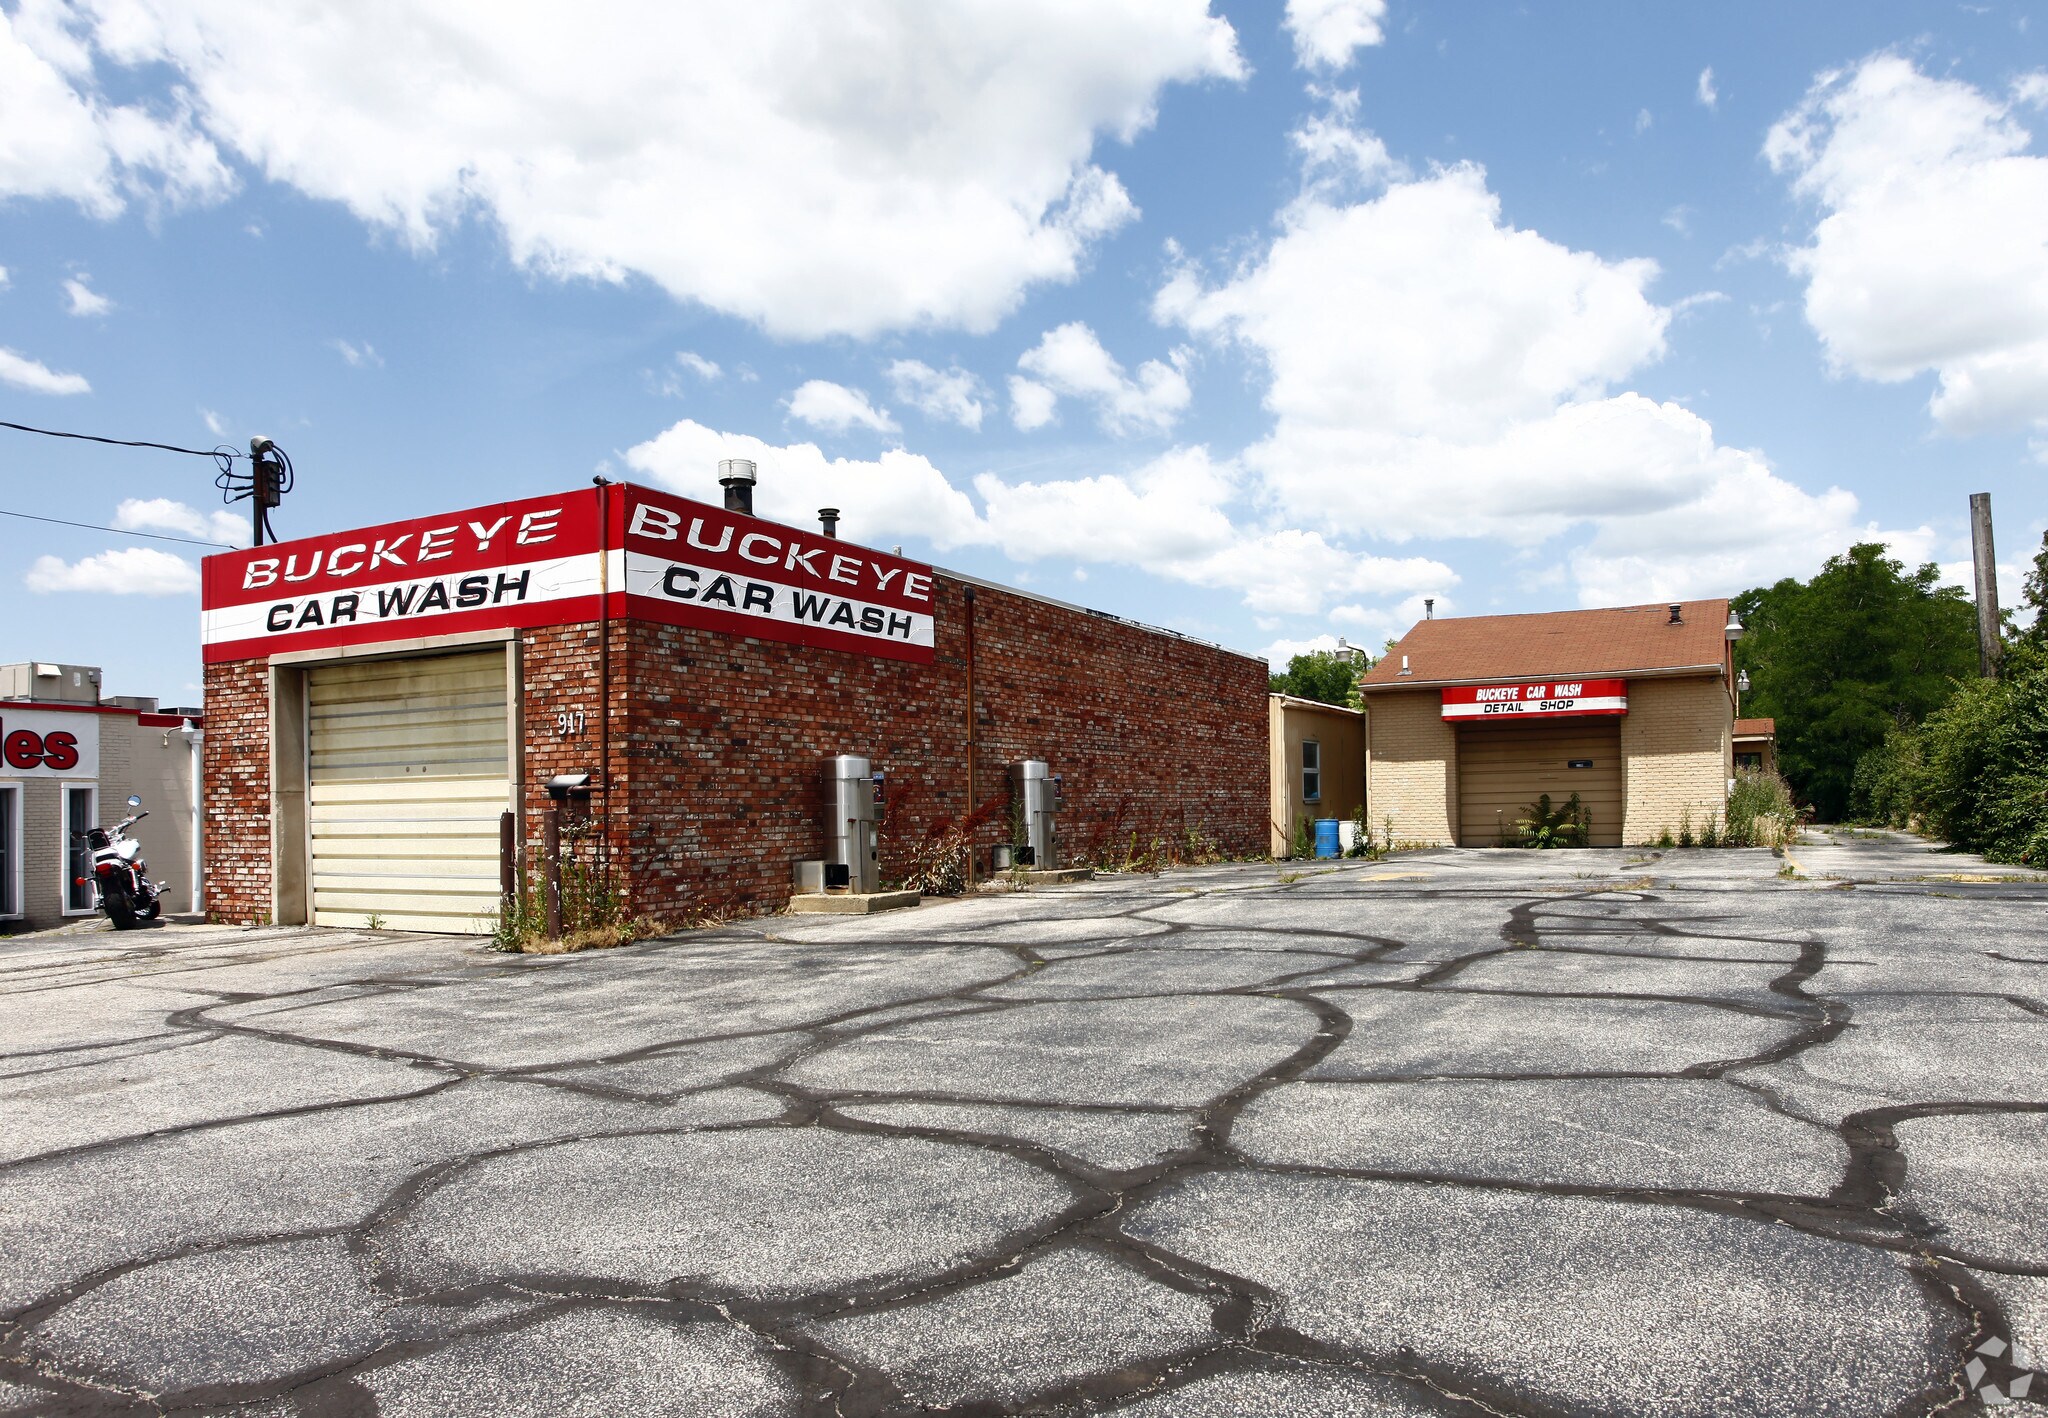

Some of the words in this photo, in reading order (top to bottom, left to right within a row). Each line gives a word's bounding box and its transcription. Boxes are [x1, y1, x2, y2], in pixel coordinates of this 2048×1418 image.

[242, 508, 562, 590] BUCKEYE
[628, 503, 932, 601] BUCKEYE
[267, 594, 358, 632] CAR
[378, 570, 530, 618] WASH
[663, 567, 774, 613] CAR
[793, 592, 912, 639] WASH
[1476, 687, 1519, 701] BUCKEYE
[1526, 686, 1545, 698] CAR
[1554, 684, 1582, 697] WASH
[1484, 703, 1523, 713] DETAIL
[1540, 700, 1574, 710] SHOP
[0, 716, 79, 770] es
[558, 712, 584, 735] 917
